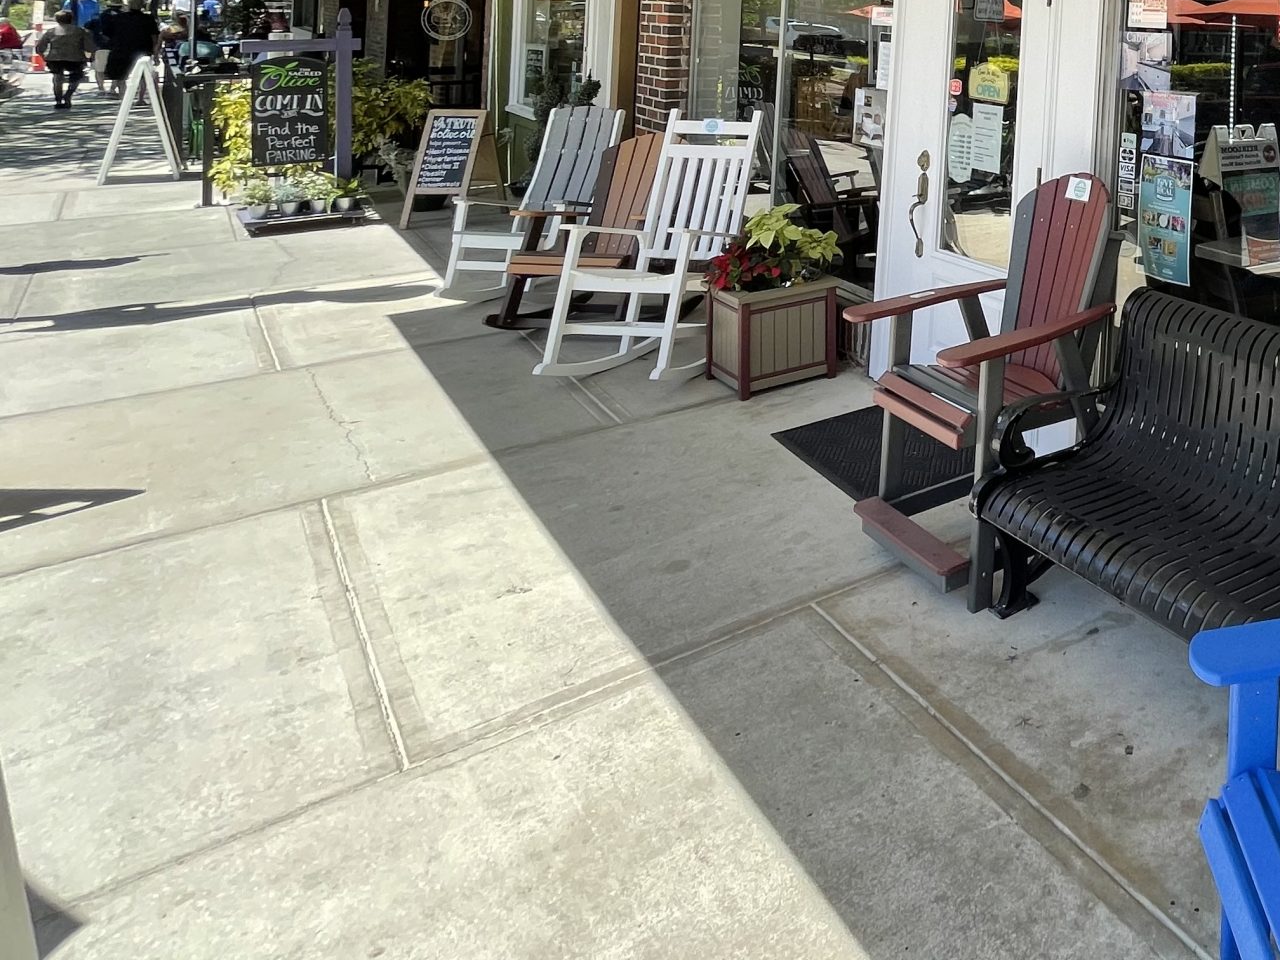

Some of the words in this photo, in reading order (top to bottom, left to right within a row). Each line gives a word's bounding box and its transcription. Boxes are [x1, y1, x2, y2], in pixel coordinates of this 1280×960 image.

[260, 71, 321, 91] Olive
[977, 84, 1000, 98] OPEN
[255, 94, 301, 110] COME
[305, 94, 324, 110] IN
[257, 121, 291, 136] Find
[294, 122, 320, 135] the
[437, 129, 459, 139] olive
[459, 129, 476, 139] oil
[266, 134, 316, 150] Perfect
[266, 148, 316, 163] PAIRING
[1120, 164, 1134, 173] VISA
